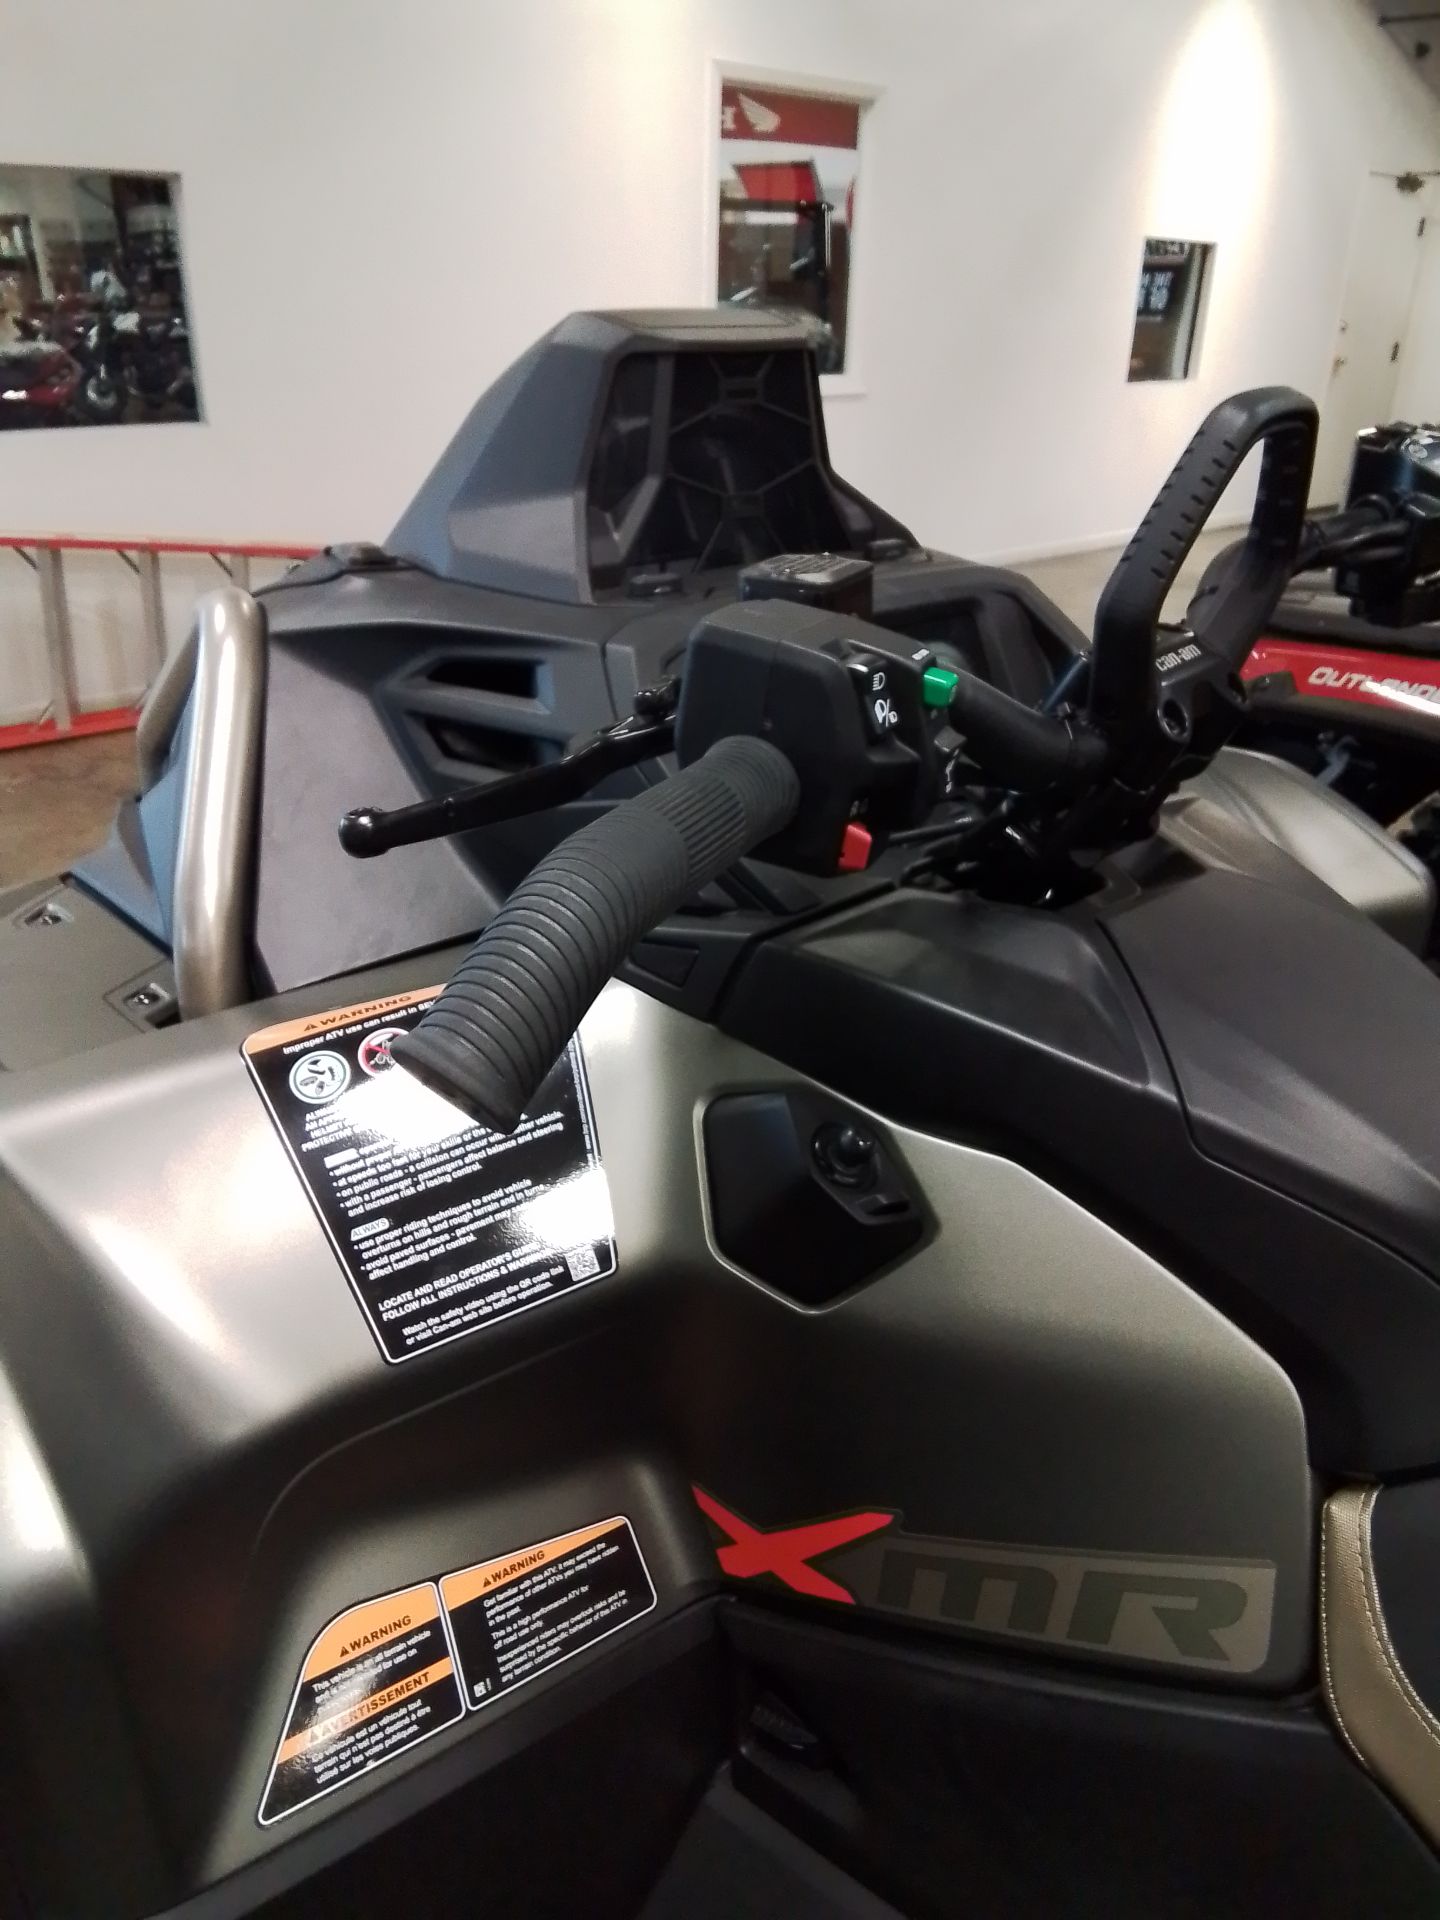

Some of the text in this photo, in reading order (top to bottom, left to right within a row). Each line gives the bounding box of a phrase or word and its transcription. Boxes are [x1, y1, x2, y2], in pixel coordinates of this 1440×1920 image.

[320, 996, 412, 1026] WARNING
[282, 1035, 326, 1057] Improper
[324, 1029, 345, 1041] ATV
[345, 1024, 363, 1034] use
[363, 1018, 381, 1029] can
[381, 1009, 407, 1023] result
[358, 1239, 375, 1250] use
[374, 1227, 404, 1245] proper
[402, 1216, 429, 1235] riding
[401, 1234, 414, 1245] on
[413, 1226, 432, 1240] hills
[432, 1220, 449, 1233] and
[364, 1254, 389, 1271] avoid
[388, 1245, 416, 1262] paved
[414, 1231, 450, 1252] surfaces
[392, 1250, 430, 1273] handling
[428, 1244, 446, 1257] and
[378, 1251, 513, 1312] LOCATE AND READ OPERATOR'S
[381, 1264, 508, 1322] FOLLOW ALL INSTRUCTIONS &
[491, 1550, 545, 1582] WARNING
[349, 1614, 412, 1653] WARNING
